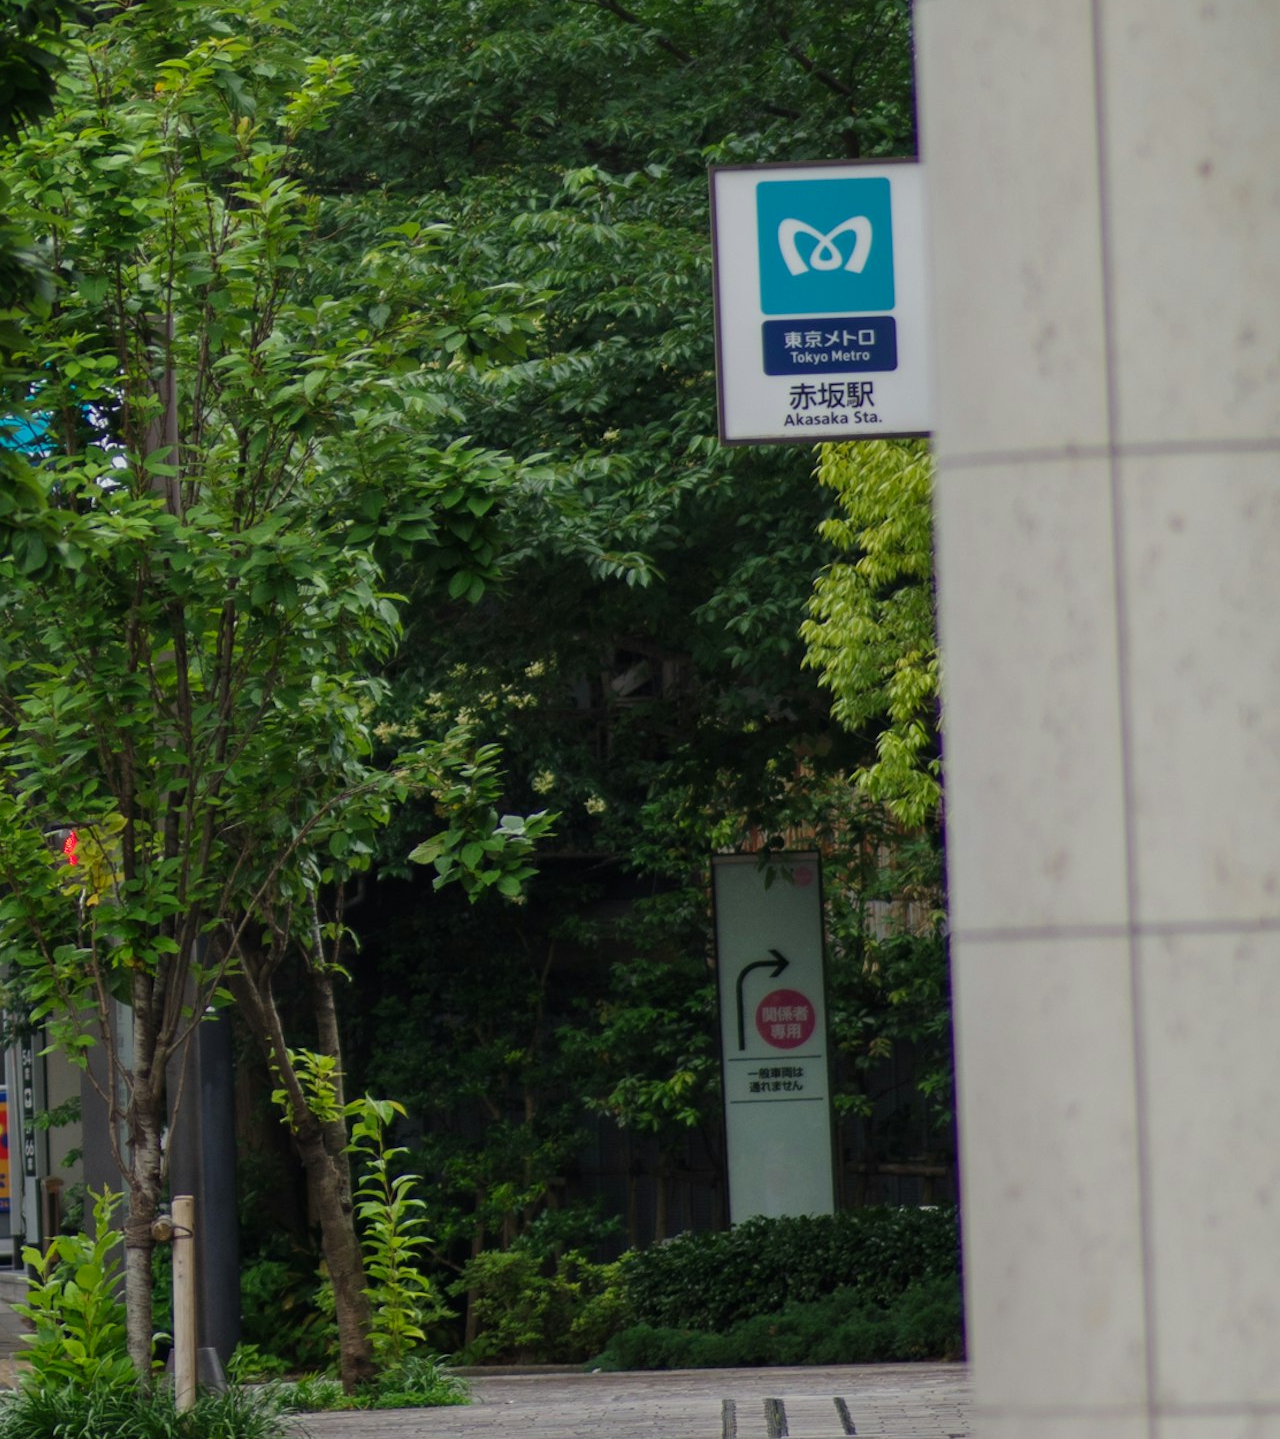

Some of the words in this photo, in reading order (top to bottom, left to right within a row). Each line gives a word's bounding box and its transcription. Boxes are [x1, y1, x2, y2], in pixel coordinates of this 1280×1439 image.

[784, 329, 875, 349] 東京メトロ
[790, 351, 828, 364] Tokyo
[831, 350, 870, 362] Metro
[789, 381, 874, 410] 赤坂駅
[784, 412, 848, 426] Akasaka
[854, 411, 882, 424] Sta.
[762, 1006, 808, 1022] 関係者
[770, 1024, 802, 1040] 専用
[747, 1067, 804, 1079] 一般車両は
[749, 1081, 804, 1093] 通れません
